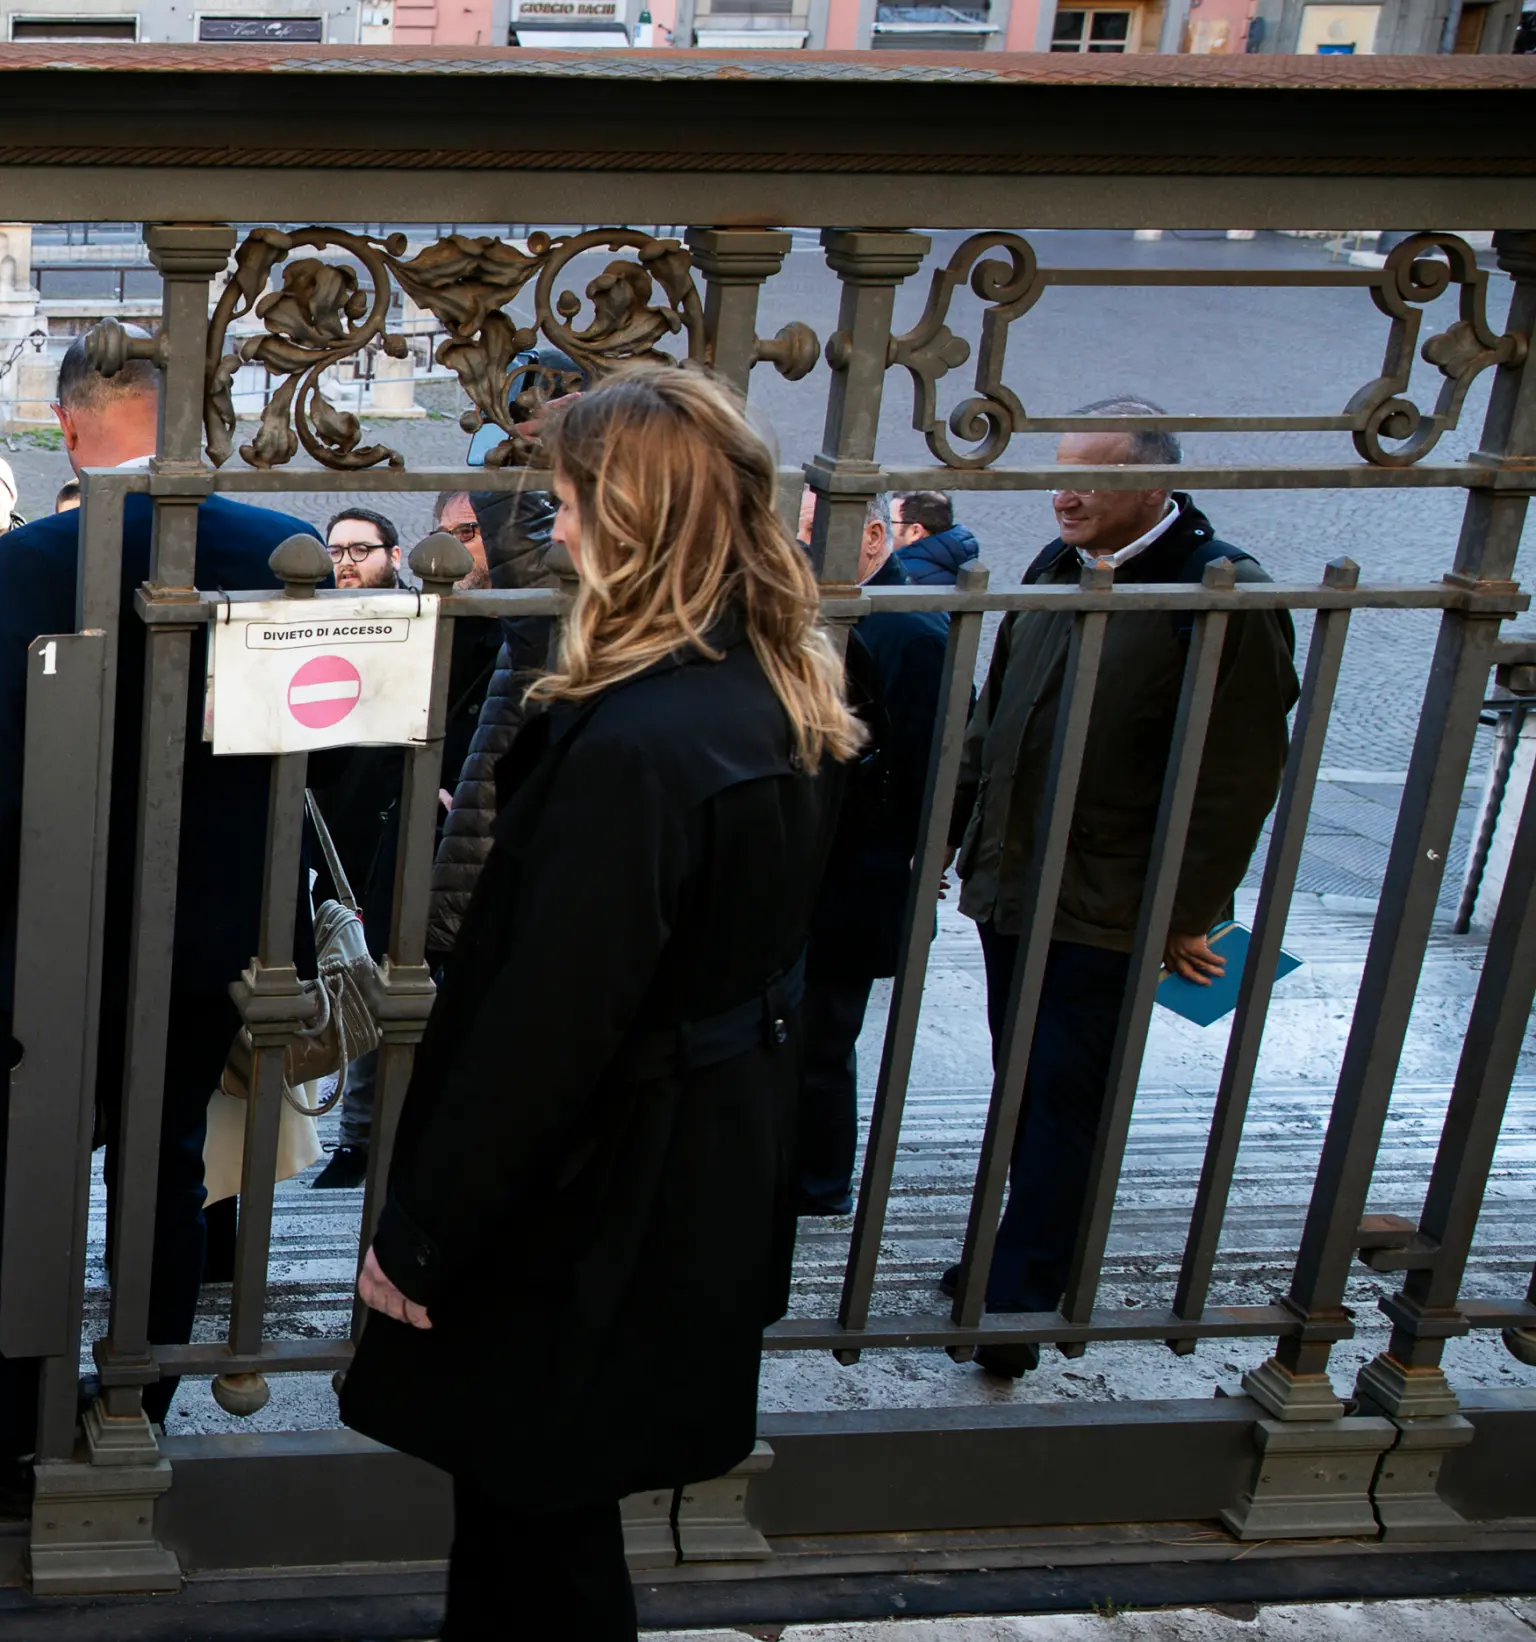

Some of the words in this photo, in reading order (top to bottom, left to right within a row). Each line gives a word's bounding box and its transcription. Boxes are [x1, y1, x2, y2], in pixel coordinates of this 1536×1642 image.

[263, 629, 313, 641] DIVIETO
[316, 627, 329, 637] DI
[332, 625, 393, 636] ACCESSO
[38, 641, 57, 675] 1
